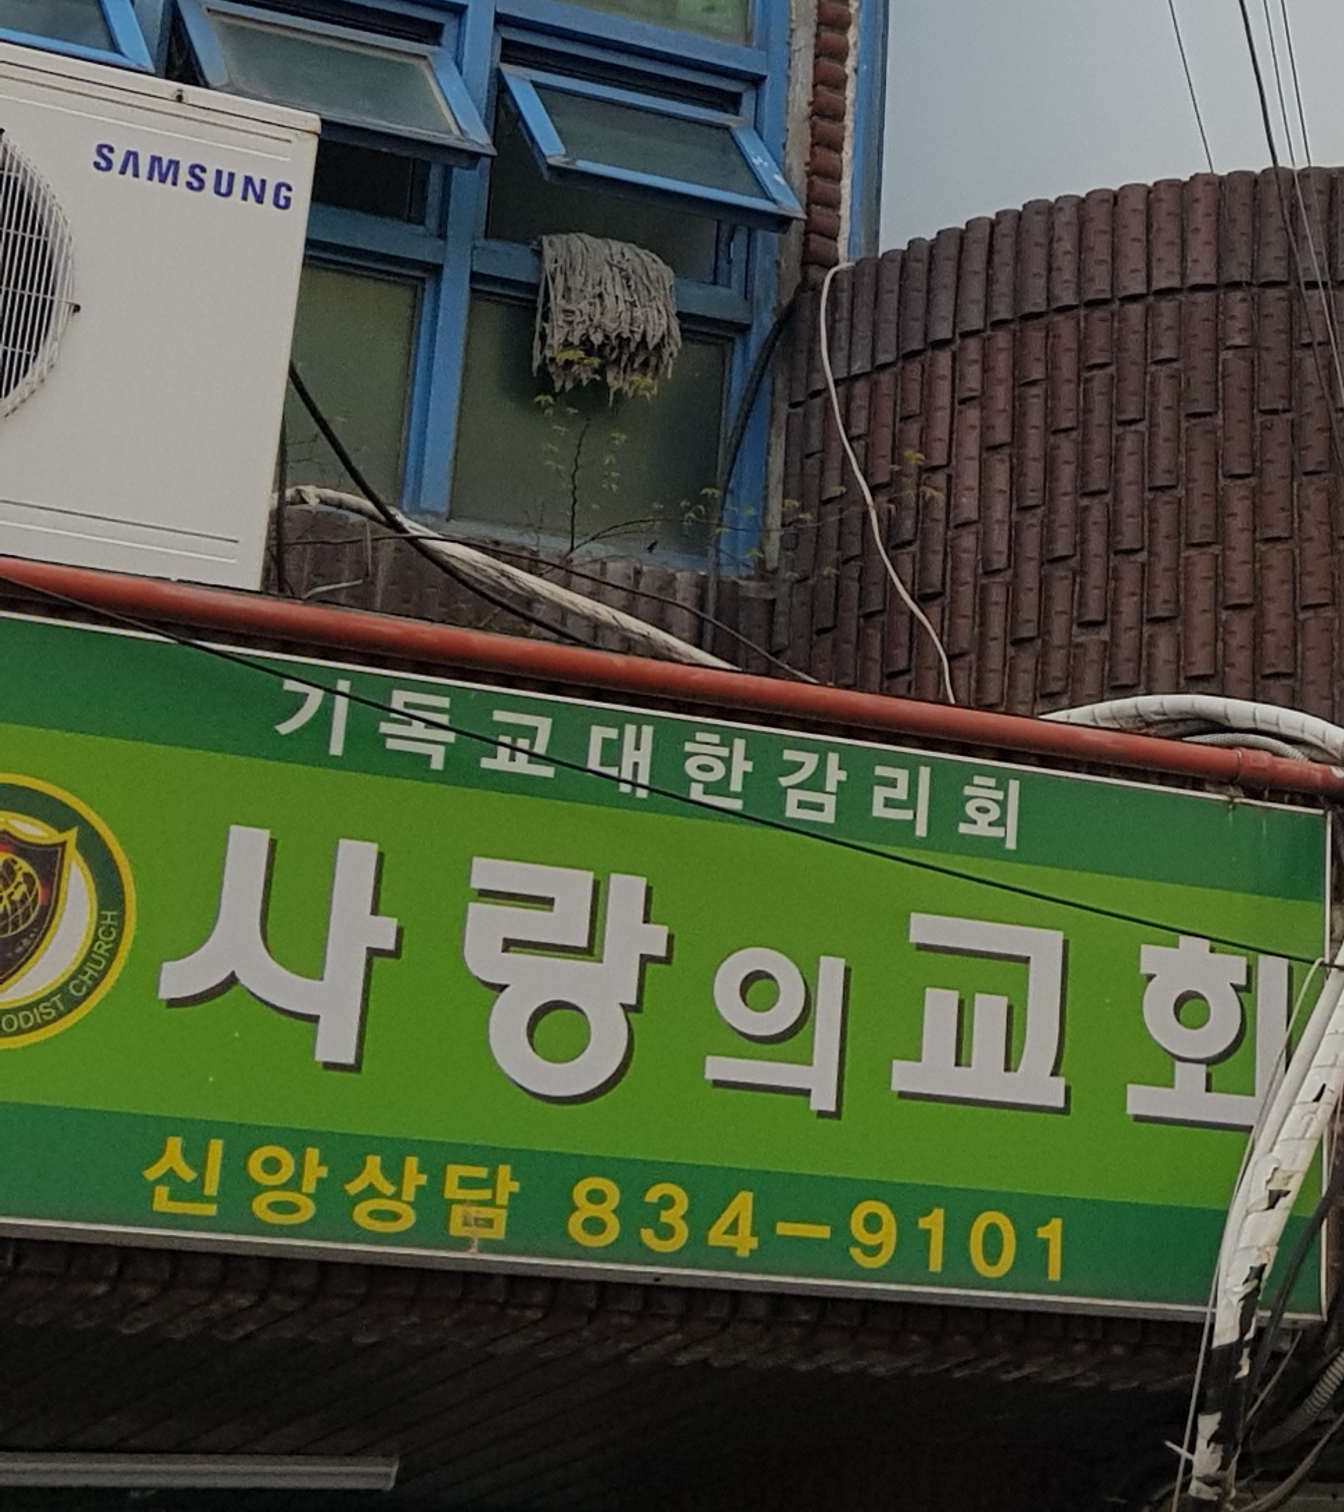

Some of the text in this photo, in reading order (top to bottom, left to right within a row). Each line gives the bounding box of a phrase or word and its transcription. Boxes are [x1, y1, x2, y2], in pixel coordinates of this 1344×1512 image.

[92, 143, 294, 211] SAMSUNG
[69, 910, 118, 998] CHURCH
[142, 1135, 1065, 1282] 신앙상담 834-9101
